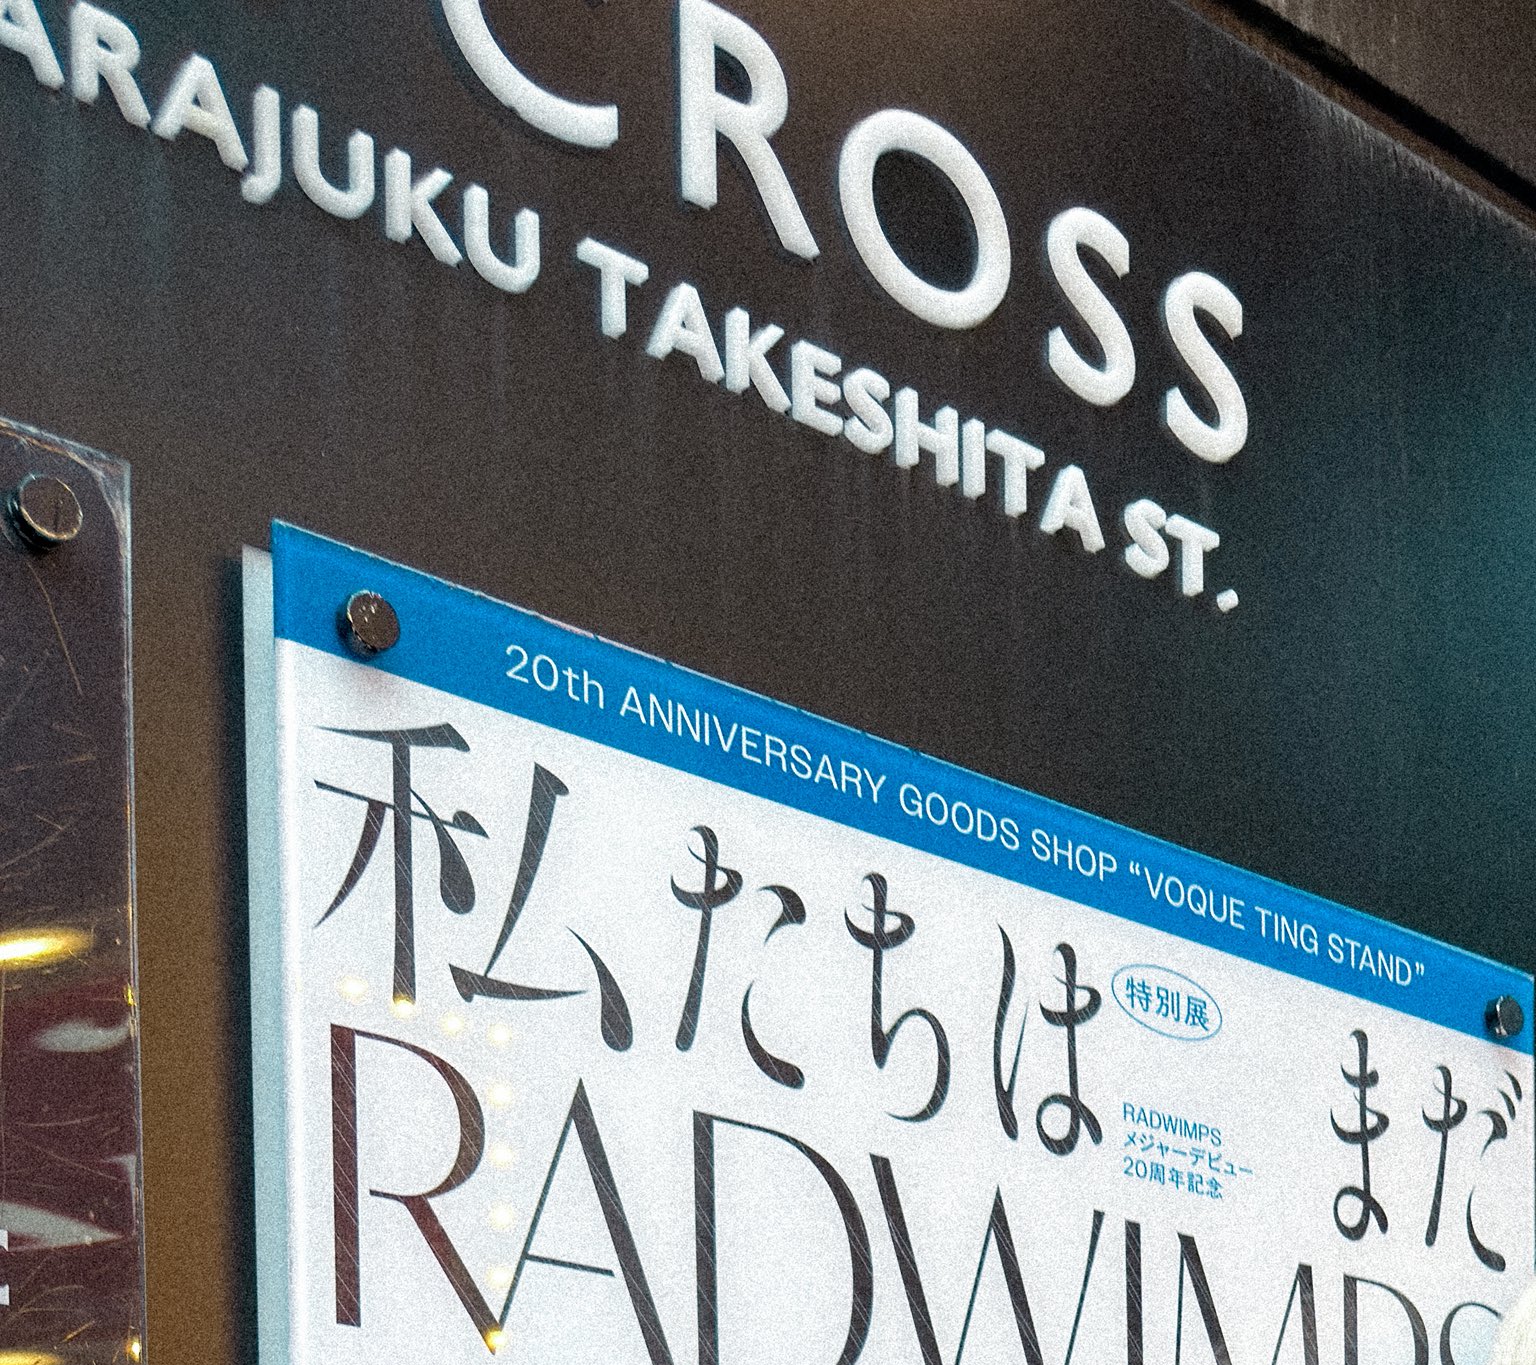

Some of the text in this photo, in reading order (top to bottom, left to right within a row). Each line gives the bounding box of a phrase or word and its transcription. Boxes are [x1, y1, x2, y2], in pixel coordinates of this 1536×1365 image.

[577, 237, 1106, 554] TAKESHITA
[1124, 498, 1240, 613] ST.
[505, 645, 604, 710] 20th
[620, 685, 886, 804] ANNIVERSARY
[899, 783, 1020, 851] GOODS
[1031, 828, 1117, 882] SHOP
[1255, 905, 1318, 957] TING
[312, 722, 1523, 1273] 私たちは まだ
[1125, 975, 1211, 1032] 特別展
[1123, 1102, 1223, 1147] RADWIMPS
[1123, 1131, 1255, 1177] メジャーデビュー
[1123, 1156, 1224, 1200] 20周年記念
